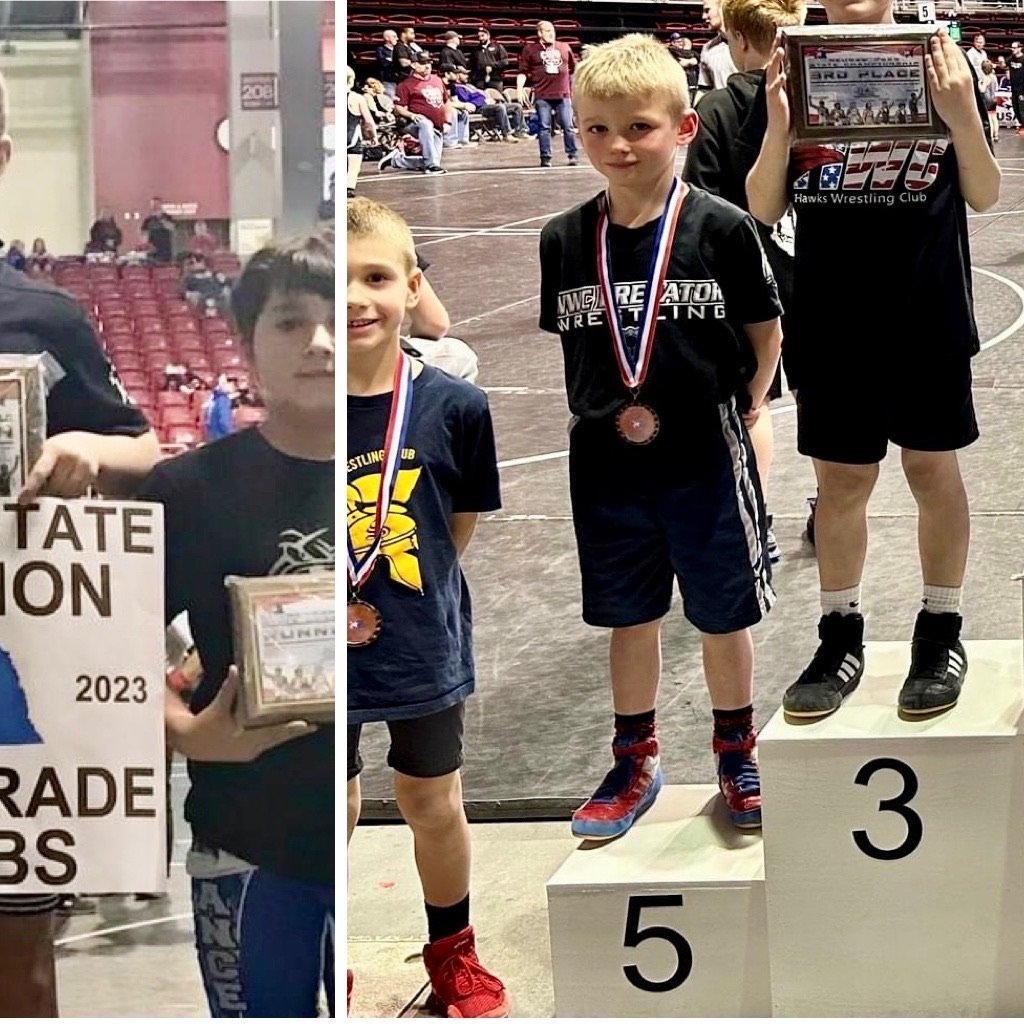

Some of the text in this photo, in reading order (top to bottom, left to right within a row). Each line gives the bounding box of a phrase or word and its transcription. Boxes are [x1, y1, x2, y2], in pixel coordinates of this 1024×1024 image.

[922, 5, 928, 17] 5
[859, 69, 920, 79] PLACE
[794, 192, 927, 206] Hawks Wrestling Club
[557, 305, 725, 332] WRETING
[75, 675, 148, 704] 2023
[852, 757, 923, 861] 3
[623, 894, 693, 992] 5
